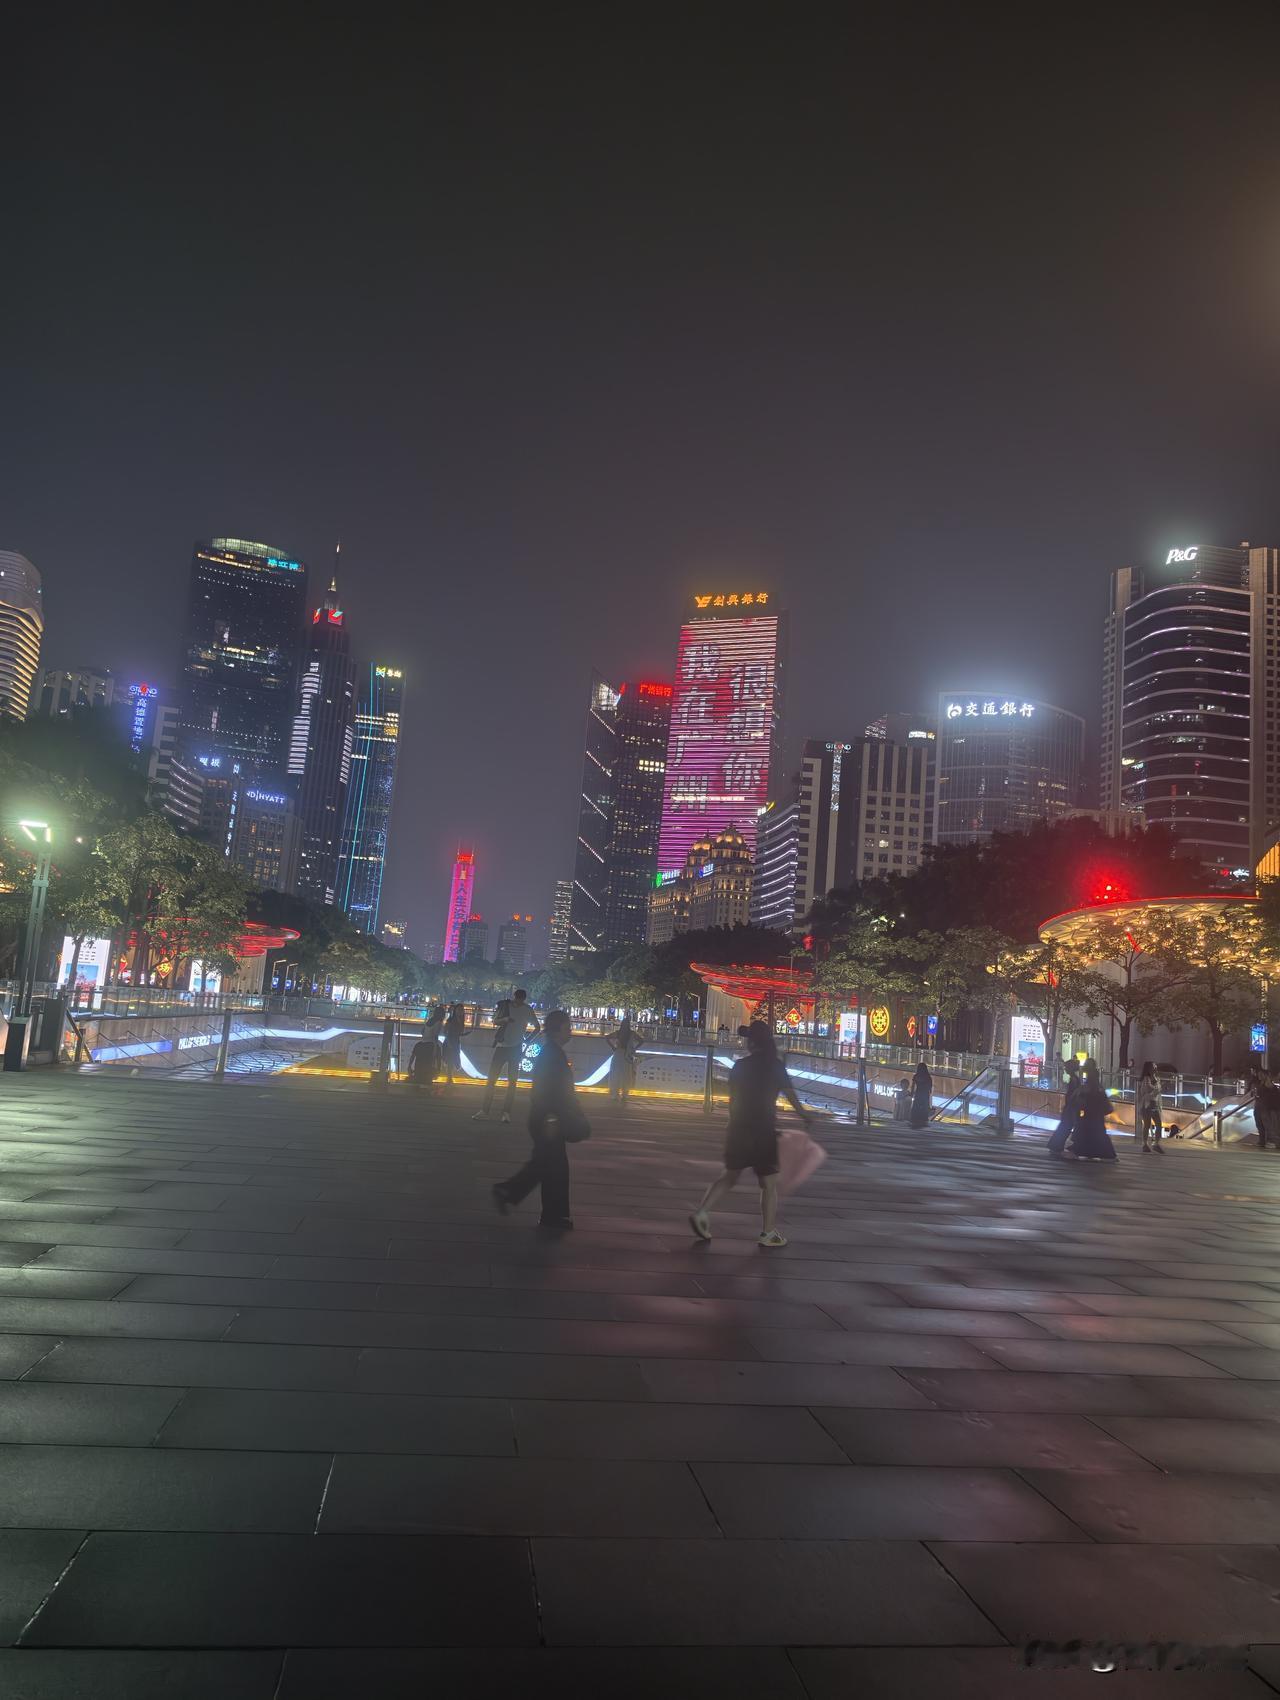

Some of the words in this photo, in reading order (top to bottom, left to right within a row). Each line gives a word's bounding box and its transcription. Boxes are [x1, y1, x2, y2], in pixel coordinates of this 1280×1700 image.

[1165, 546, 1198, 565] P&G
[640, 684, 672, 697] 广州银行
[671, 642, 719, 814] 我在广州
[258, 791, 285, 805] HYATT
